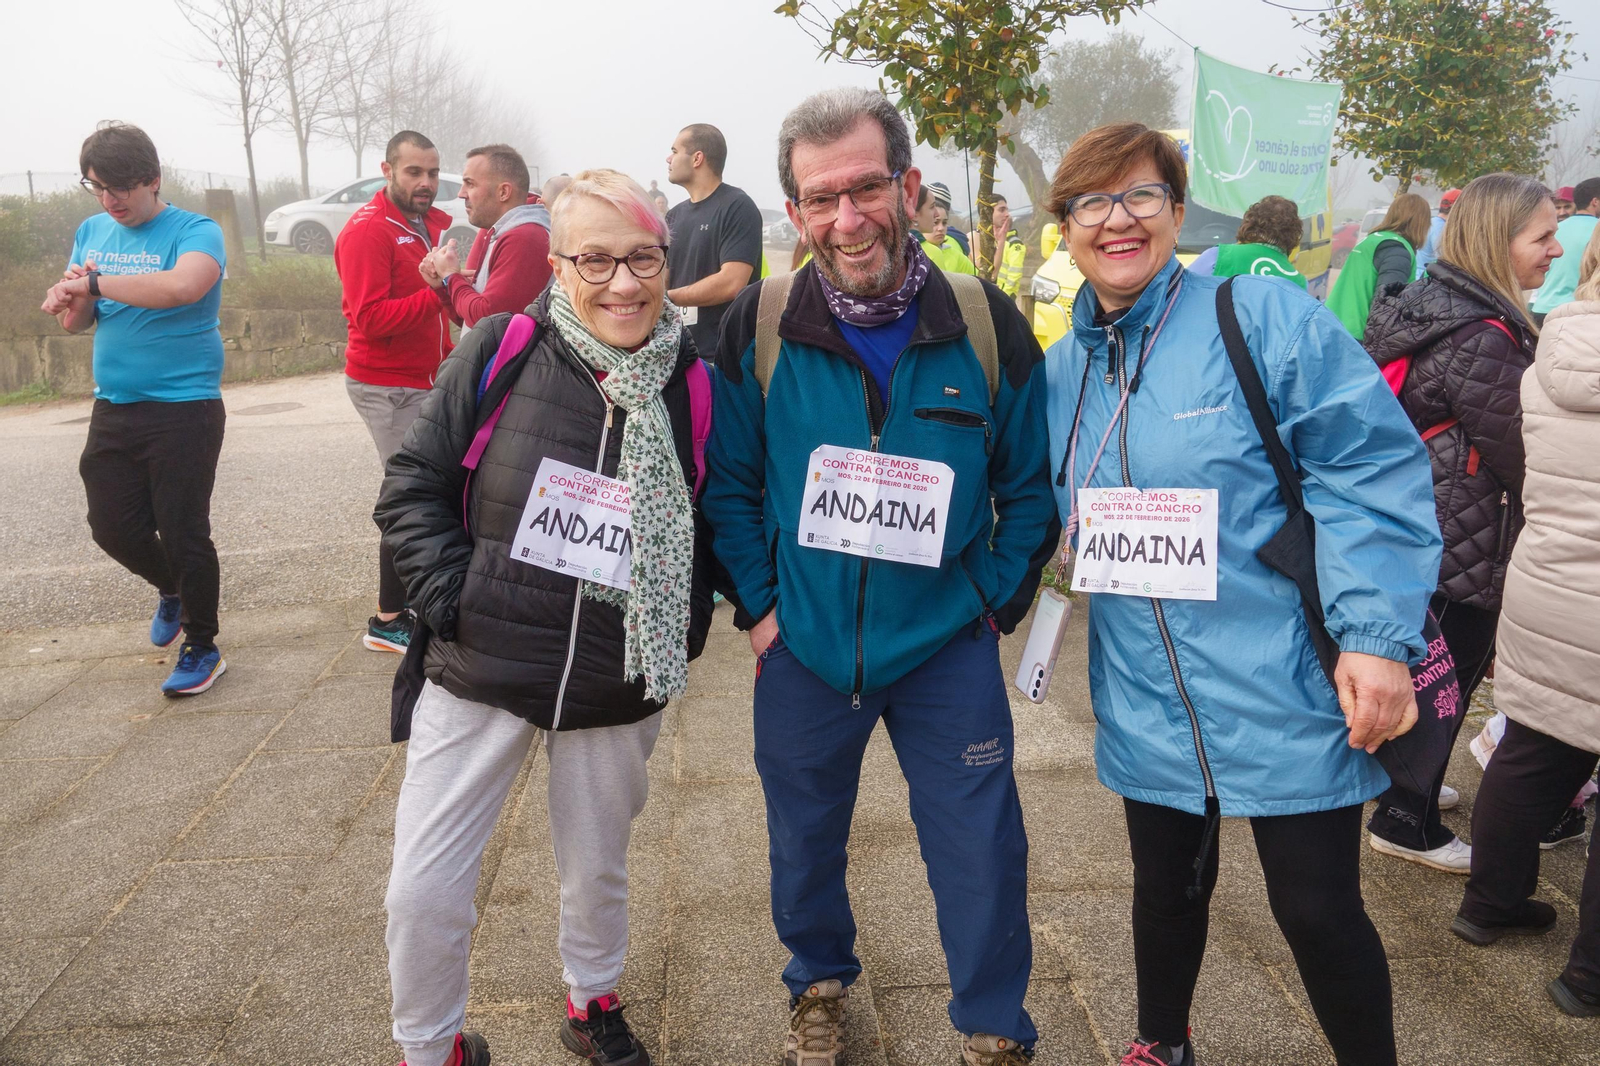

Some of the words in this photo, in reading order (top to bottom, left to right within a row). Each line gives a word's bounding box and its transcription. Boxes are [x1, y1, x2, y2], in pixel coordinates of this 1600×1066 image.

[87, 249, 102, 262] En
[104, 250, 161, 264] marcha
[98, 263, 160, 275] estigación
[822, 458, 872, 474] CONTRA
[875, 467, 884, 476] O
[886, 469, 940, 485] CANCRO
[846, 452, 920, 472] CORREMOS
[550, 475, 598, 496] CONTRA
[601, 490, 610, 499] O
[614, 494, 630, 506] CA
[573, 471, 630, 495] CORREM
[872, 478, 902, 488] FEBREIRO
[545, 493, 560, 501] MOS
[563, 490, 578, 500] MOS,
[596, 500, 627, 514] FEBREIRO
[1090, 502, 1133, 512] CONTRA
[1135, 504, 1142, 512] O
[1146, 504, 1202, 514] CANCRO
[1108, 492, 1178, 502] CORREMOS
[810, 489, 936, 534] ANDAINA
[530, 506, 632, 556] ANDAIN
[1083, 532, 1206, 566] ANDAINA
[1412, 658, 1451, 692] CONTRA
